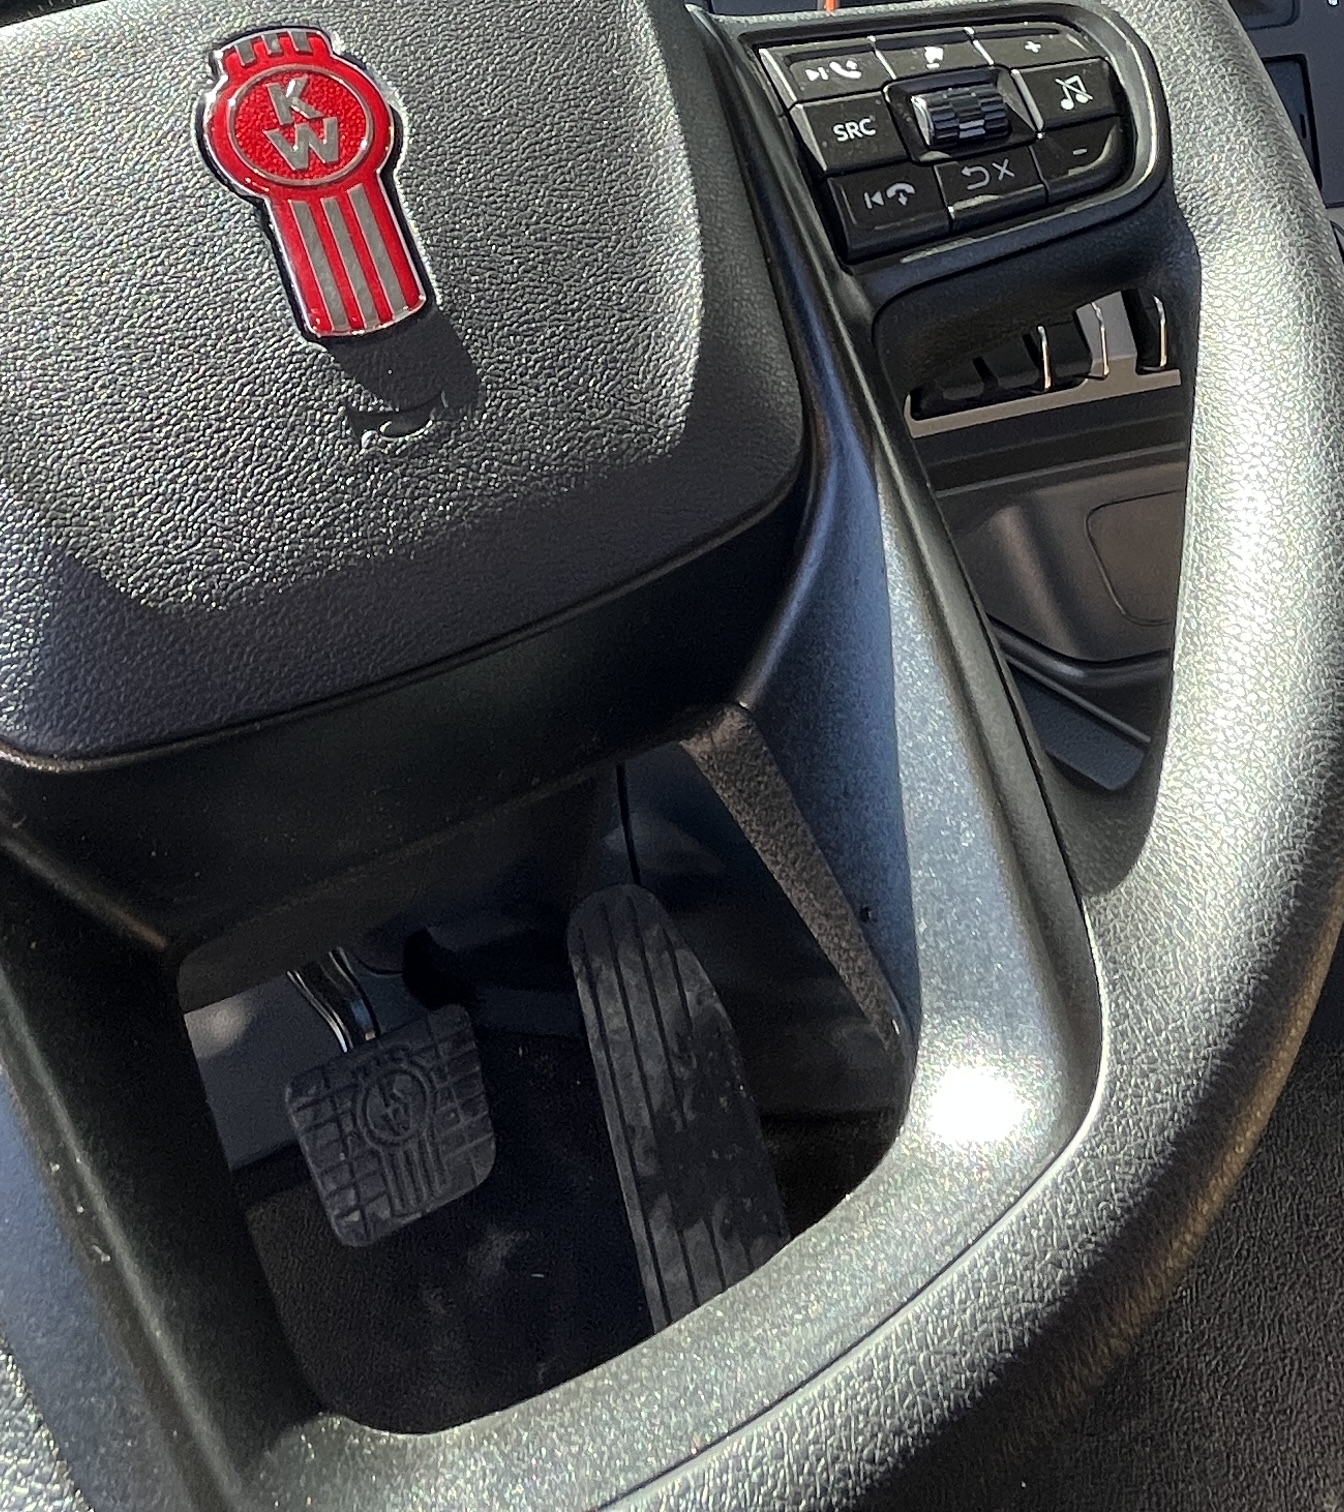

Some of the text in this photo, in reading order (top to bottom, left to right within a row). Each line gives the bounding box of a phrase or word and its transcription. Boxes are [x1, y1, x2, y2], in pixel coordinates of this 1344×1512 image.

[264, 75, 322, 125] K
[262, 117, 341, 170] W
[831, 117, 878, 144] SRC
